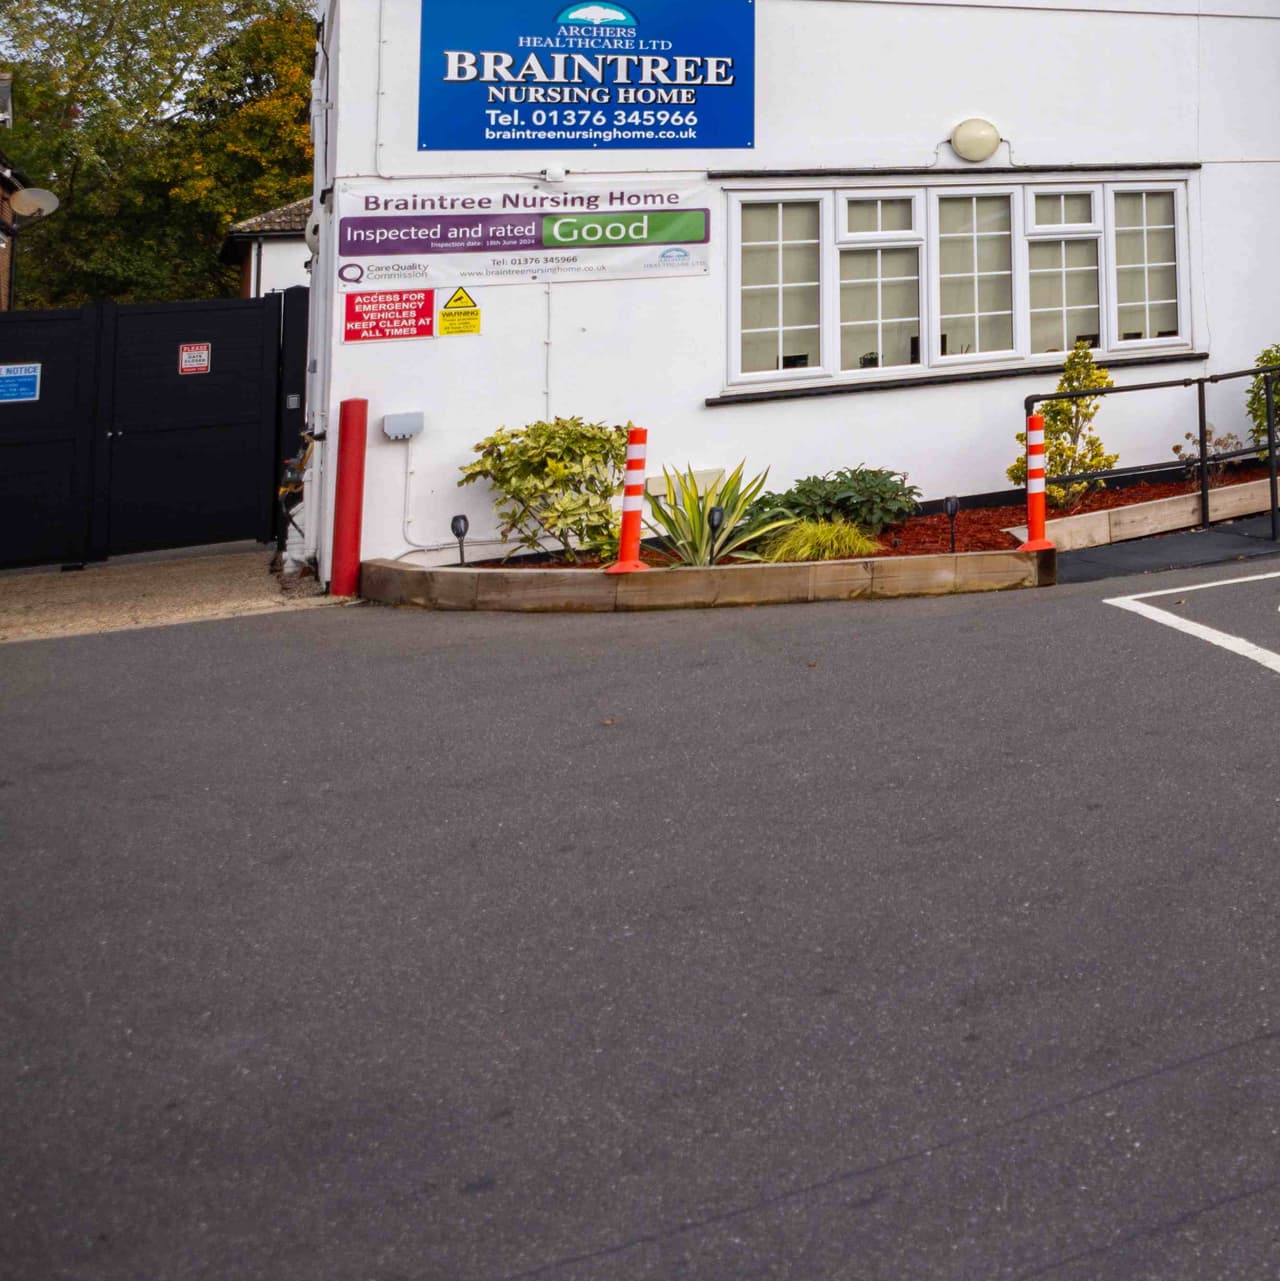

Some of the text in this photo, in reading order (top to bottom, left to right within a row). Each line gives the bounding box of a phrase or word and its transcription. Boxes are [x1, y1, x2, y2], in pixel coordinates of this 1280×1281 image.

[557, 25, 636, 38] ARCHERS
[518, 36, 673, 51] HEALTHCARE LTD
[443, 50, 735, 86] BRAINTREE
[487, 86, 697, 105] NURSING HOME
[486, 109, 698, 126] Tel. 01376 345966
[485, 127, 697, 141] braintreenursinghome.co.uk
[364, 191, 679, 211] Braintree Nursing Home
[346, 222, 535, 244] Inspected and rated
[553, 215, 648, 242] Good
[510, 257, 541, 265] 01376
[543, 255, 578, 264] 345966
[366, 271, 428, 280] Commission
[459, 264, 607, 278] www.braintreenursinghome.co.uk
[355, 293, 425, 304] ACCESS FOR
[355, 302, 424, 312] EMERGENCY
[363, 310, 416, 320] VEHICLES
[441, 310, 479, 318] WARNING
[346, 321, 377, 330] KEEP
[379, 319, 415, 328] CLEAR
[418, 318, 432, 326] AT
[361, 327, 417, 338] ALL TIMES
[6, 366, 38, 375] NOTICE
